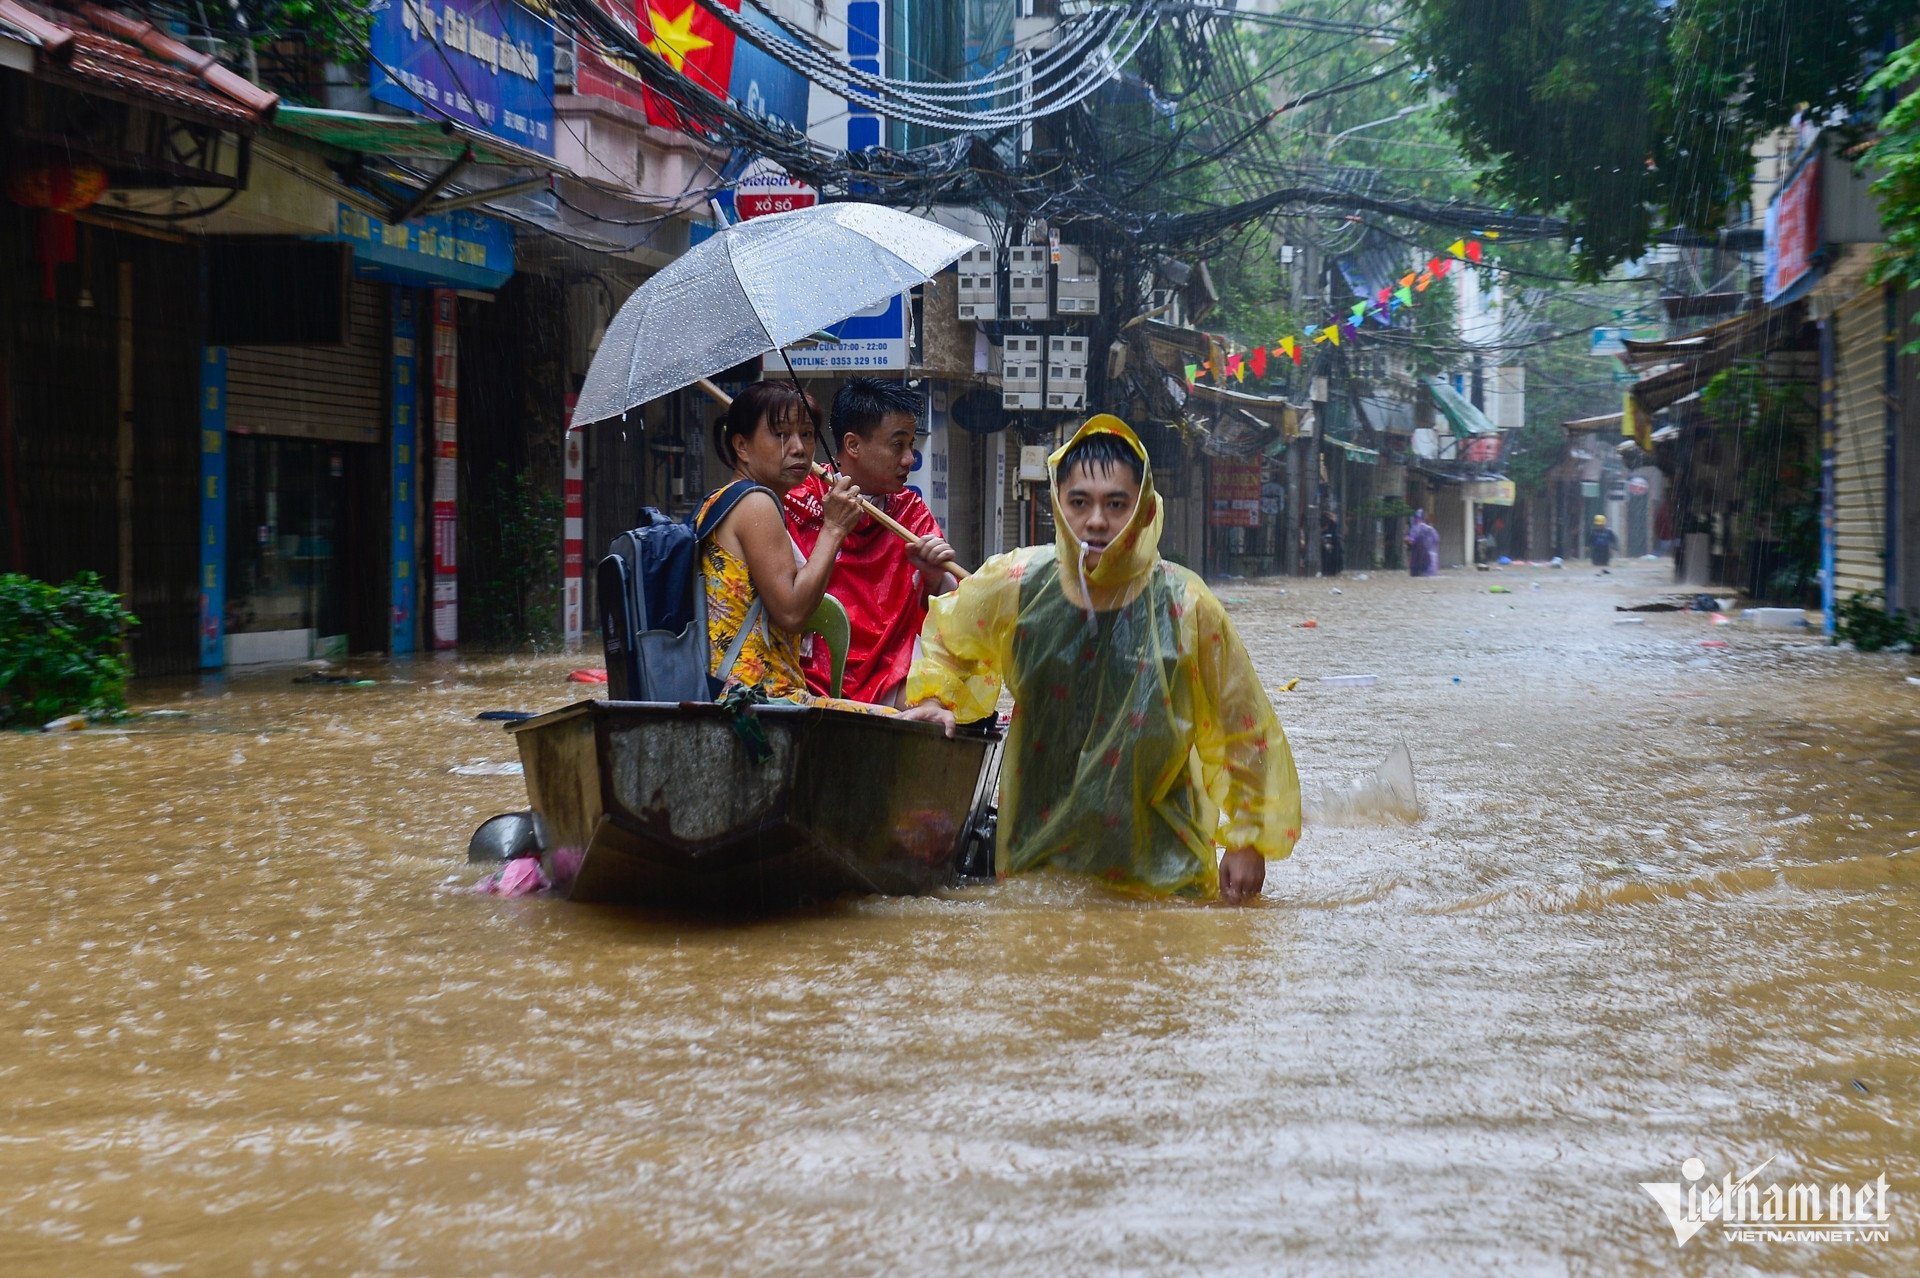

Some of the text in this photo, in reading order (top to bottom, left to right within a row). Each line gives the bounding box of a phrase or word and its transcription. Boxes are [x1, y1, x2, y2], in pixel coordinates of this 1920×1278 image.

[839, 342, 859, 352] 07:00
[866, 342, 888, 351] 22:00
[791, 356, 888, 366] HOTLINE: 0353 329 186
